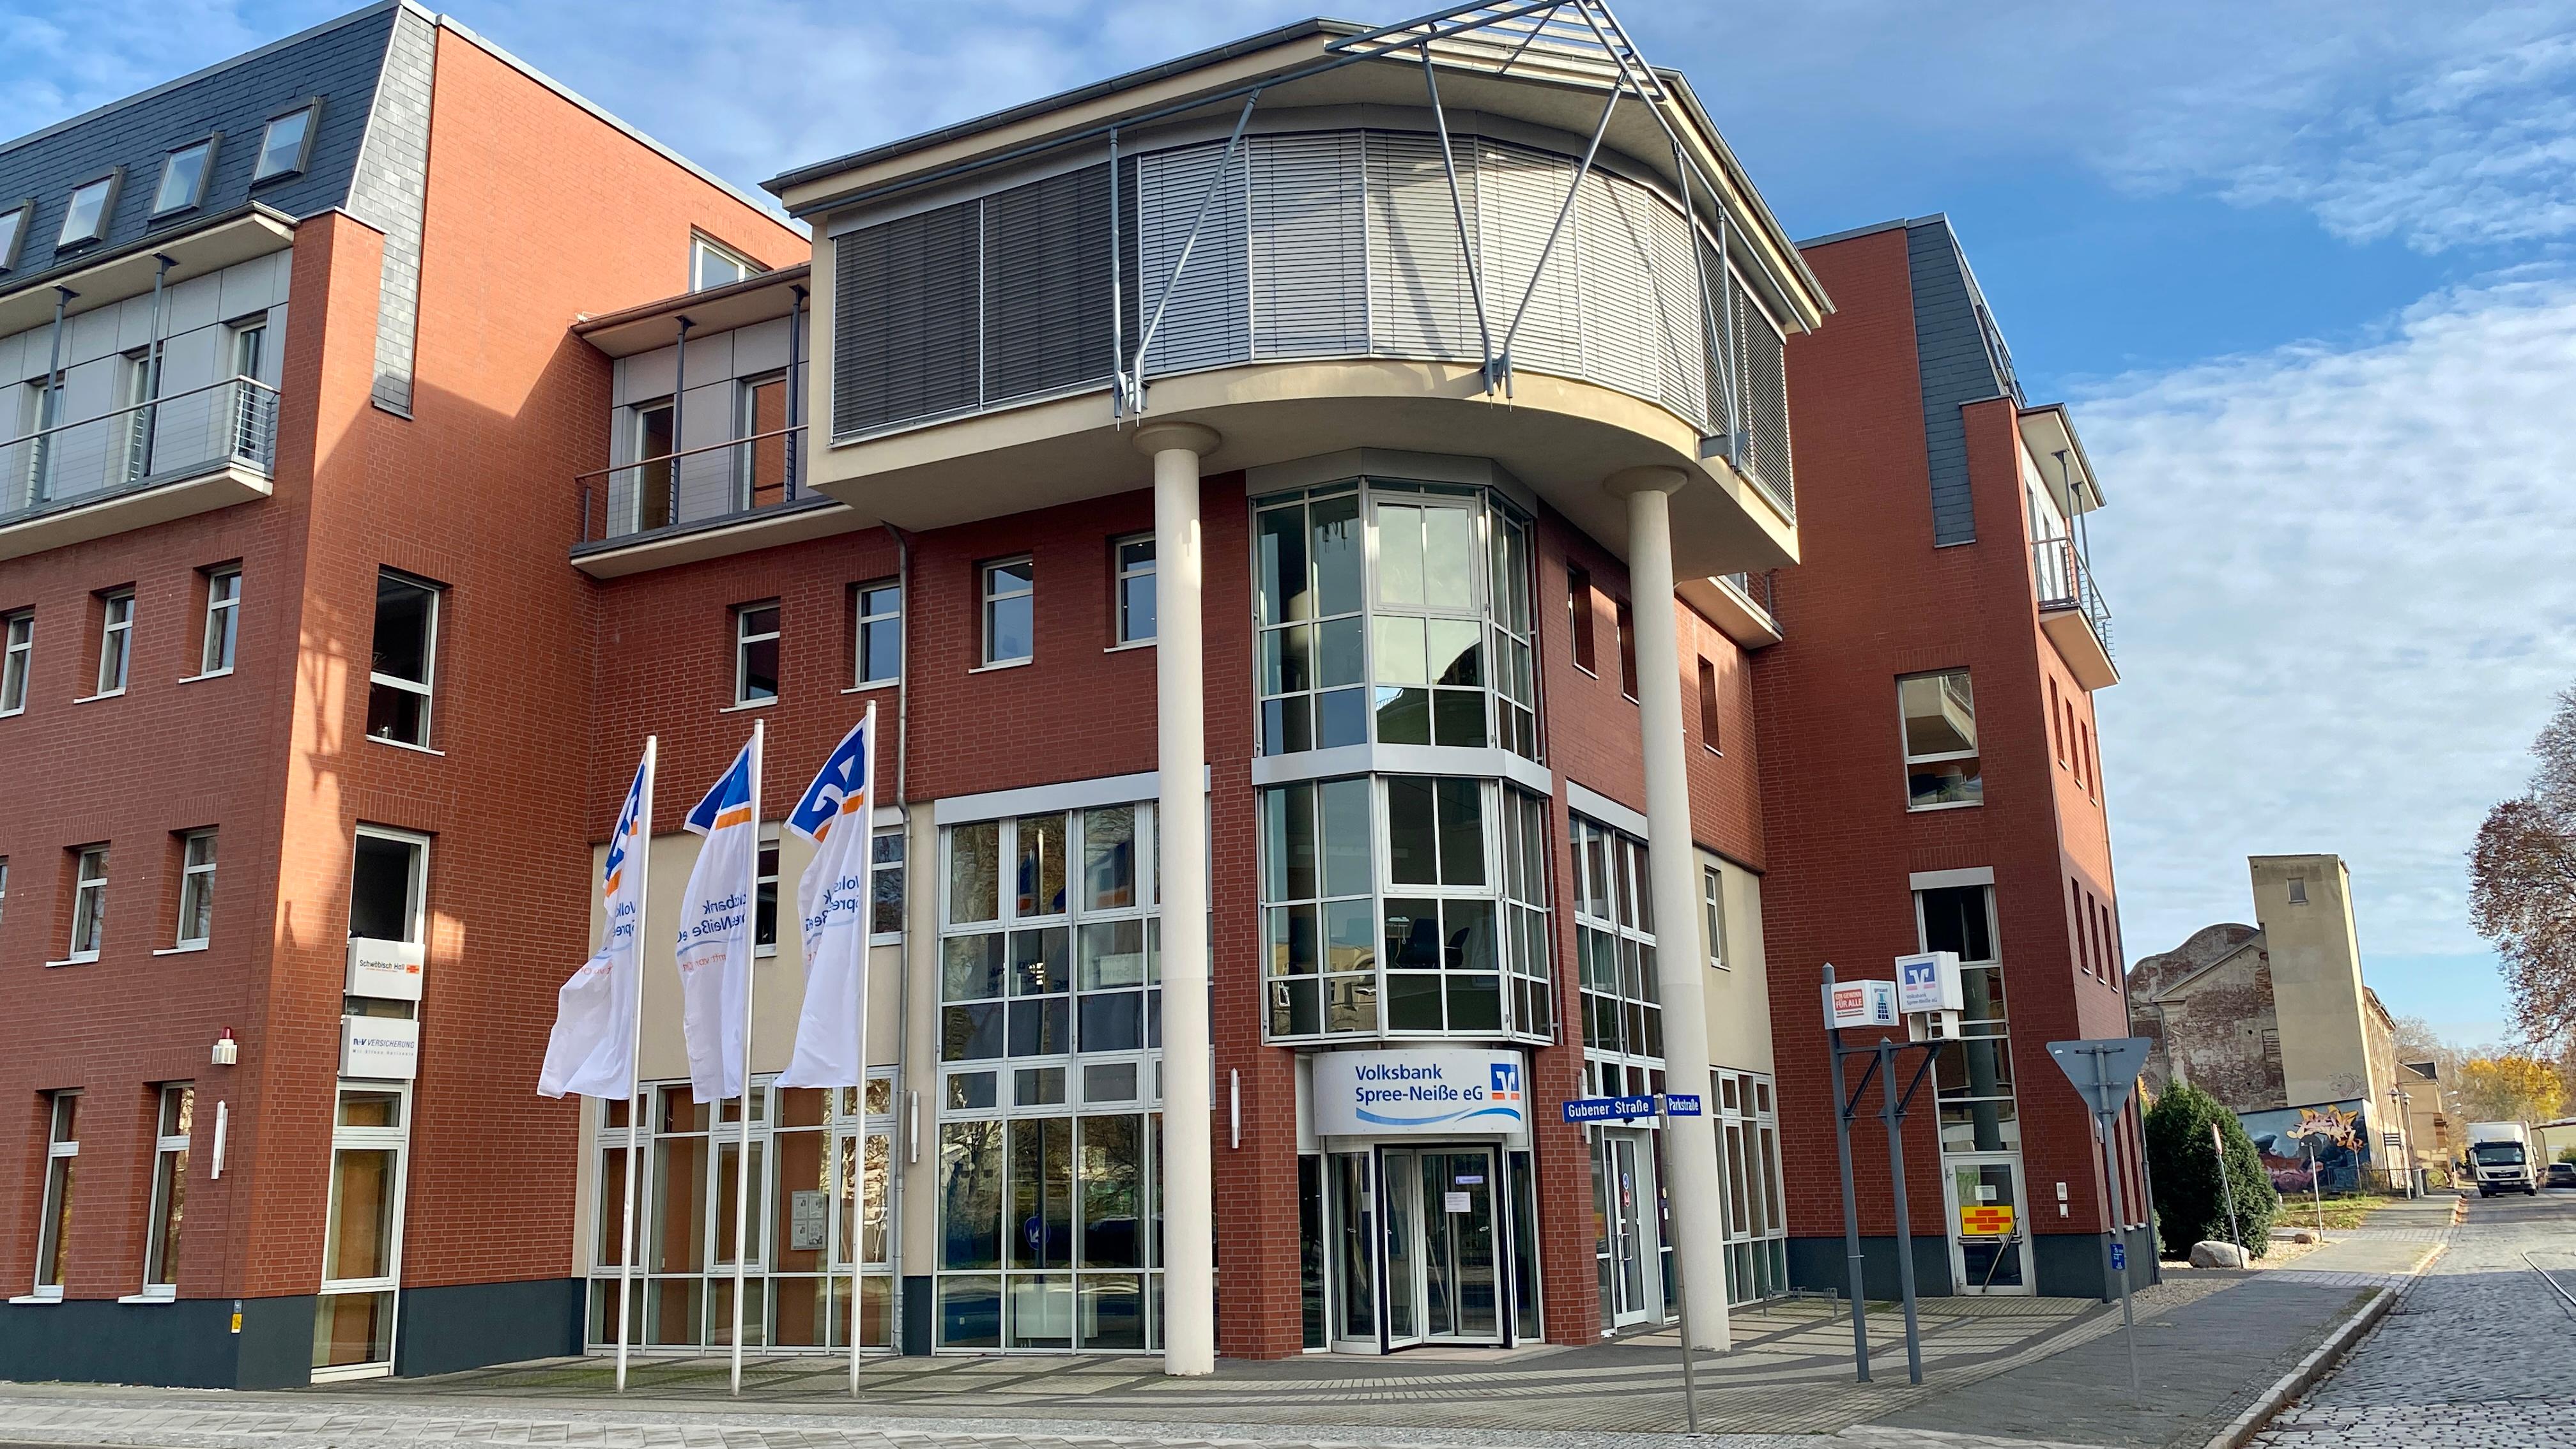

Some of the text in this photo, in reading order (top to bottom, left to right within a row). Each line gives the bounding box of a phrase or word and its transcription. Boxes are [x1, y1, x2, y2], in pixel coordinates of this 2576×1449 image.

[1836, 998, 1863, 1009] FÜR ALLE
[367, 1039, 415, 1048] VERSICHERUNG
[1355, 1063, 1443, 1080] Volksbank
[1356, 1085, 1483, 1105] Spree-Neiße eG
[1568, 1100, 1649, 1117] Gubener Straße
[1668, 1098, 1699, 1112] Parkstraße
